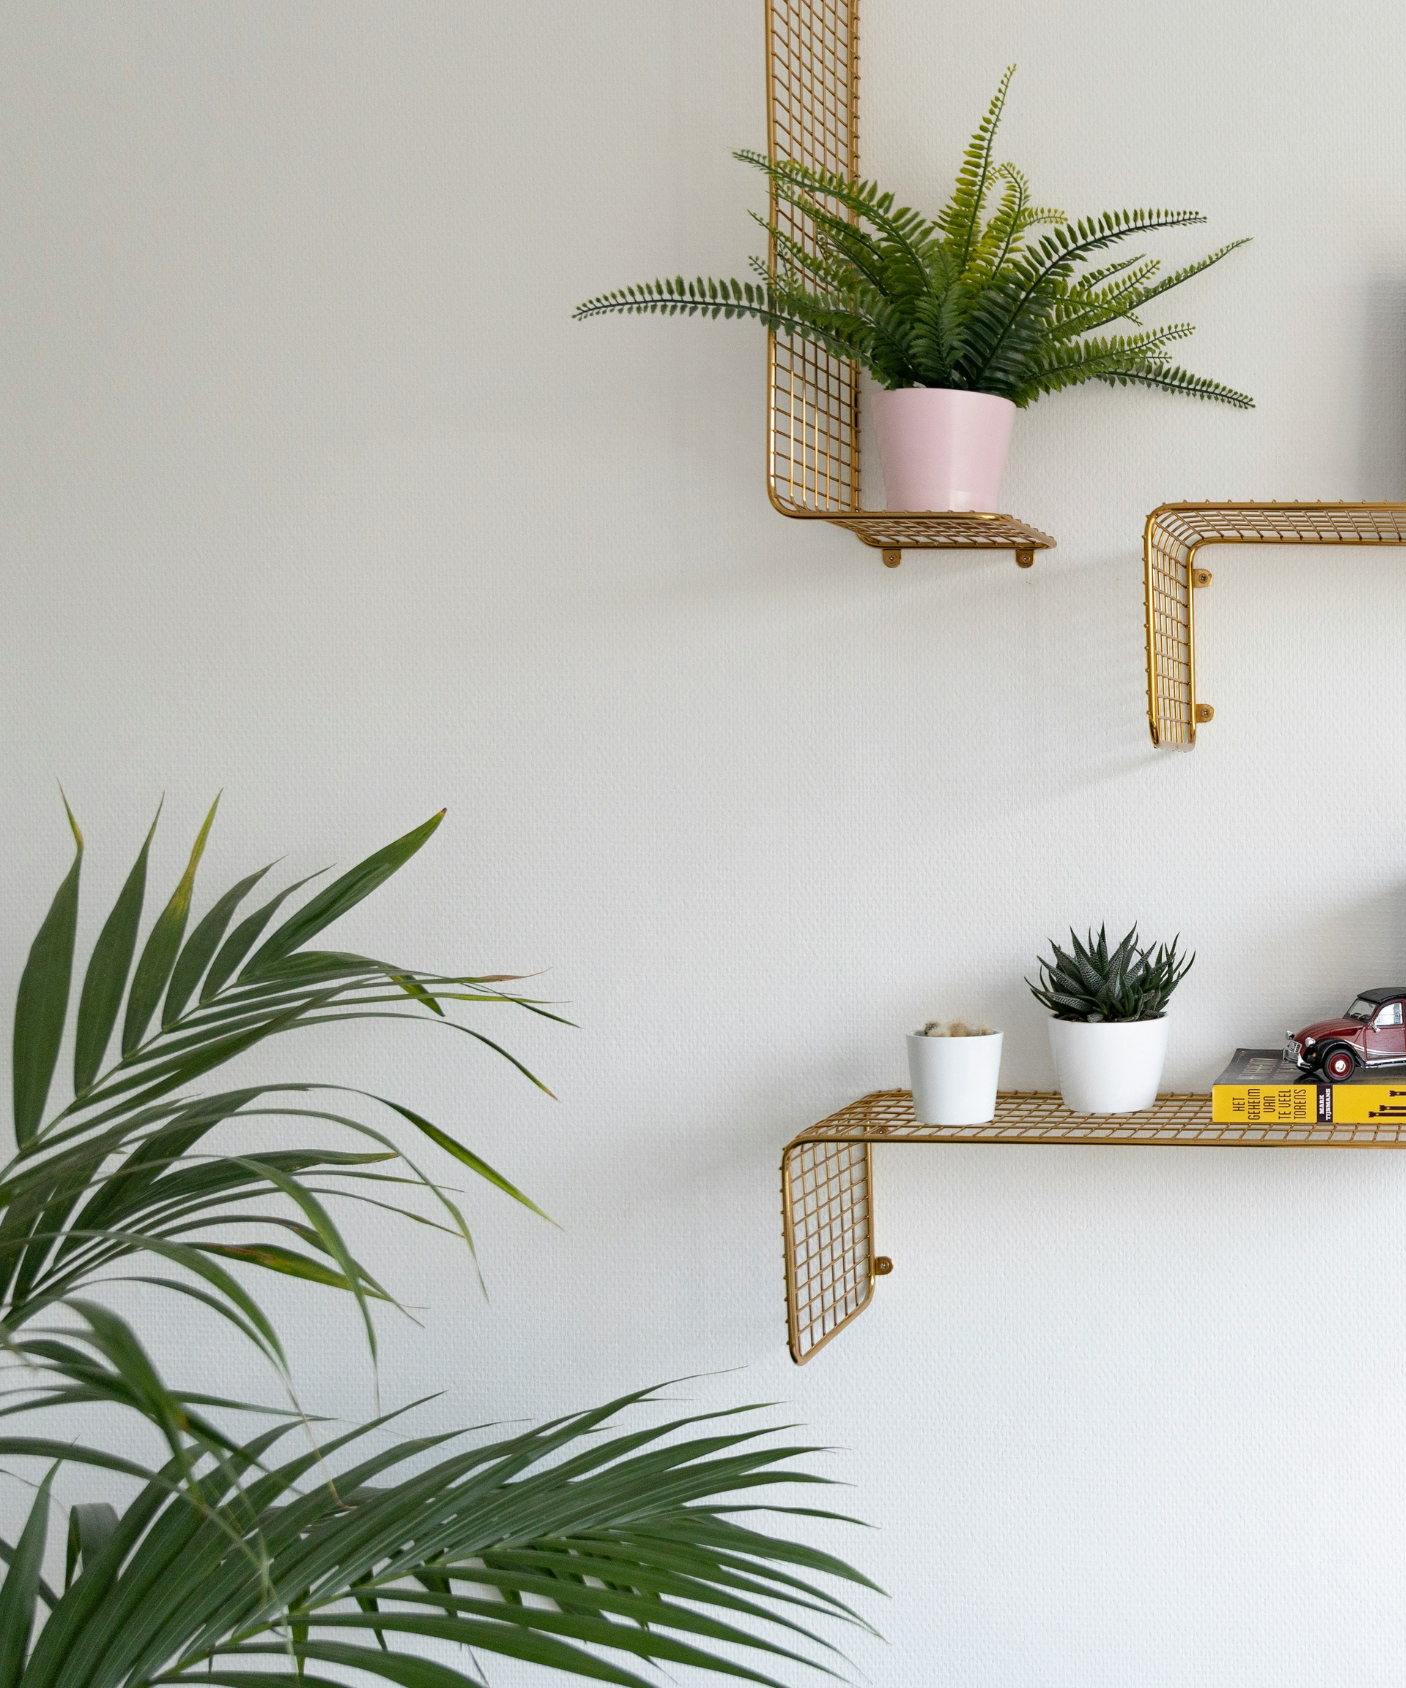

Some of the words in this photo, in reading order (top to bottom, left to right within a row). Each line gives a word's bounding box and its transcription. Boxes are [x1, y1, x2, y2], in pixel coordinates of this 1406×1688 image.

[1232, 1097, 1245, 1111] HET
[1248, 1088, 1260, 1120] GEHEIM
[1263, 1096, 1275, 1112] VAN
[1278, 1089, 1291, 1108] VEEL
[1294, 1089, 1306, 1119] TORENS
[1278, 1111, 1291, 1119] TE
